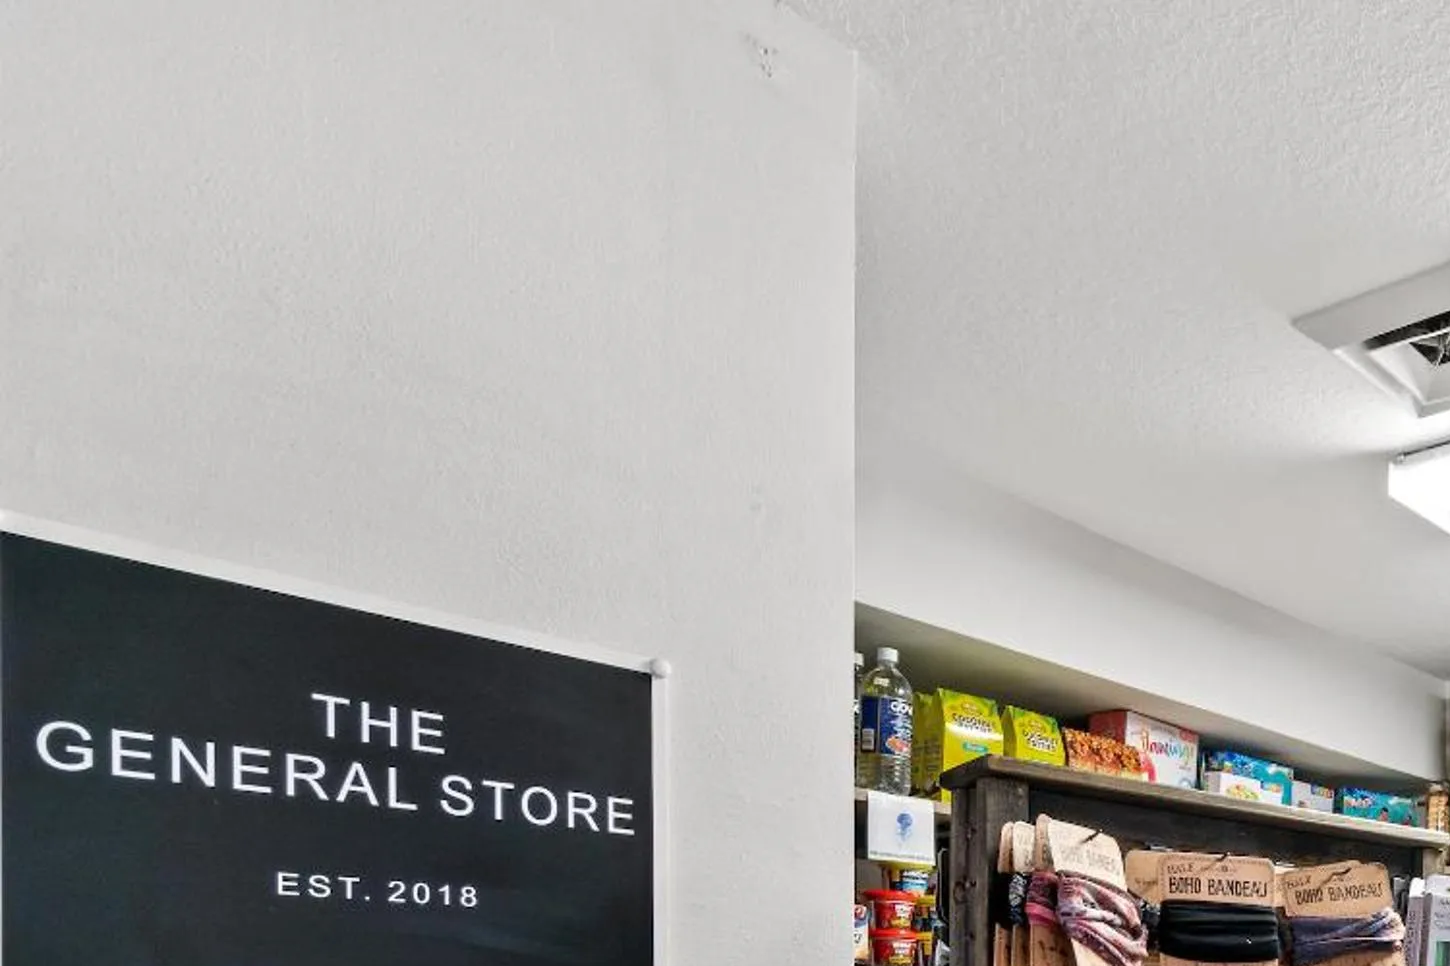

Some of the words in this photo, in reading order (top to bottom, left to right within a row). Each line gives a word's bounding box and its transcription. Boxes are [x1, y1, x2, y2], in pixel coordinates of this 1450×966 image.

[311, 692, 446, 756] THE
[35, 719, 419, 812] GENERAL
[440, 773, 637, 837] STORE
[276, 871, 371, 902] EST.
[387, 881, 479, 908] 2018
[1168, 877, 1202, 894] BOHO
[1207, 879, 1268, 898] BANDEAU
[1328, 883, 1383, 901] BANDEAU
